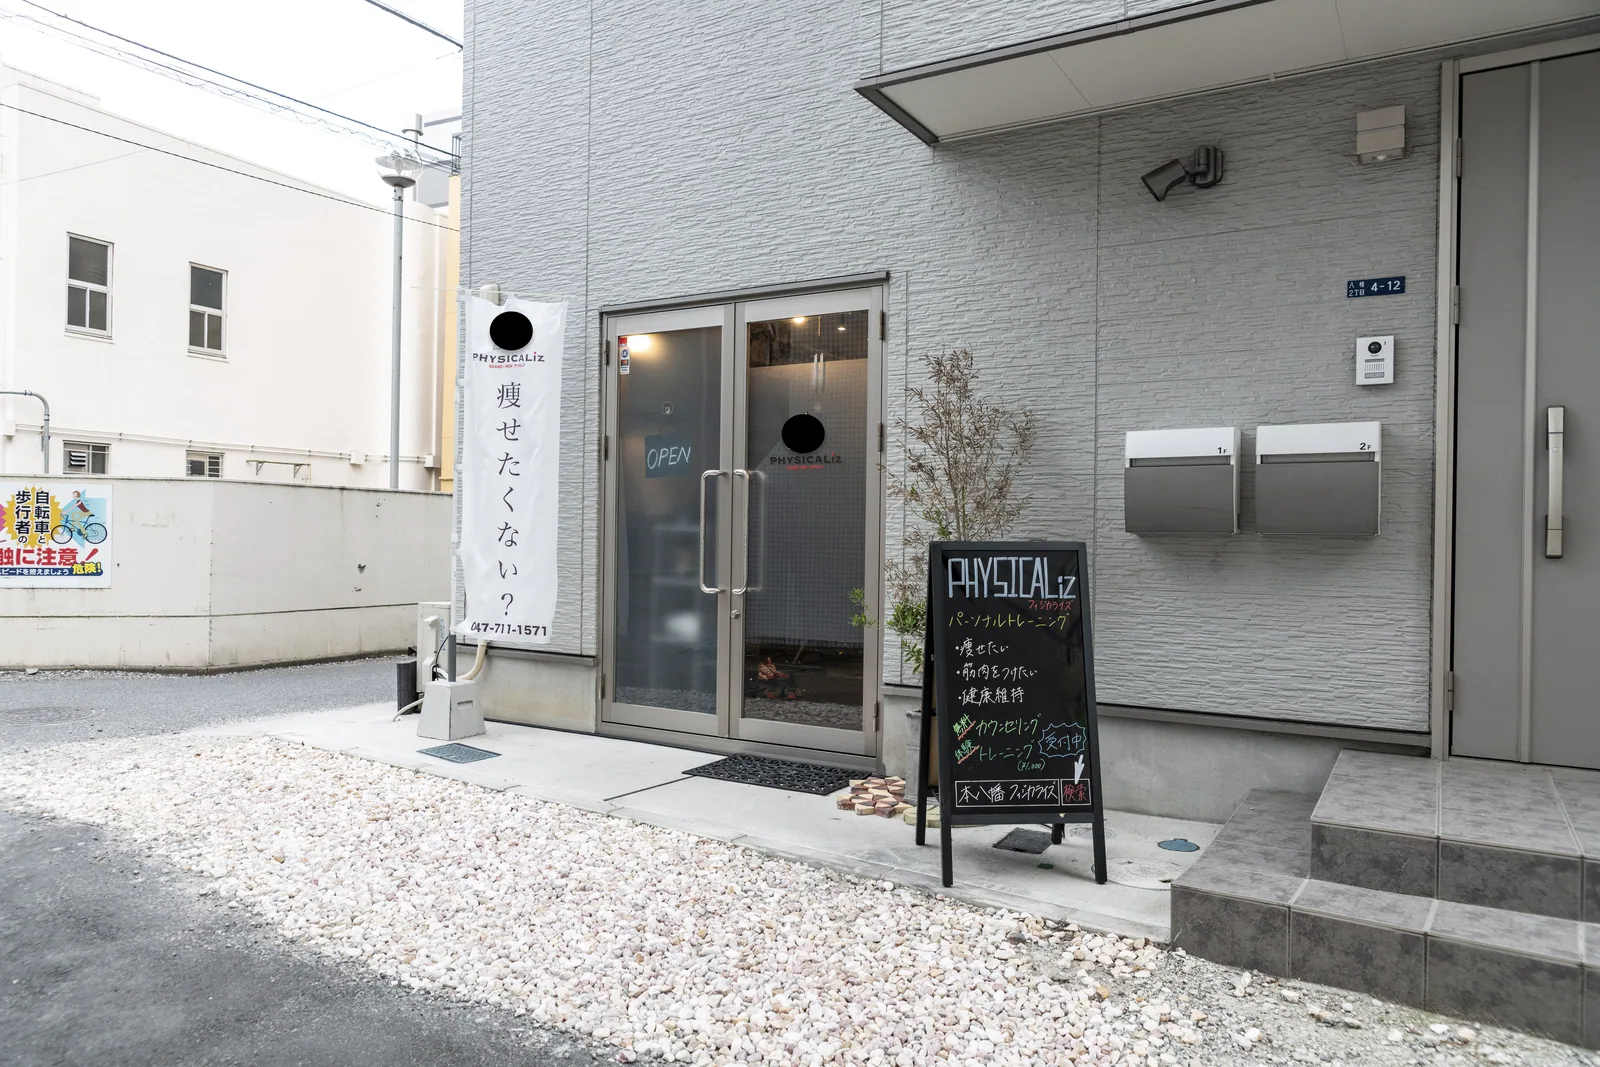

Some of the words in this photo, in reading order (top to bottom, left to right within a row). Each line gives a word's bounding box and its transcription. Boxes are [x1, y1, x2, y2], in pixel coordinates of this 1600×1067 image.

[1370, 280, 1400, 292] 4-12
[647, 446, 691, 470] OPEN
[496, 382, 522, 616] 痩せたくない？
[15, 490, 31, 544] 歩行者の
[34, 490, 50, 544] 自転車と
[470, 622, 547, 636] 047-711-1571
[948, 611, 1070, 630] パーソナルトレーニング
[976, 713, 1042, 736] カウンセリング
[980, 740, 1035, 761] トレーニング
[1045, 731, 1082, 751] 受付中
[958, 783, 1005, 803] 本八幡
[1064, 784, 1088, 802] 検索
